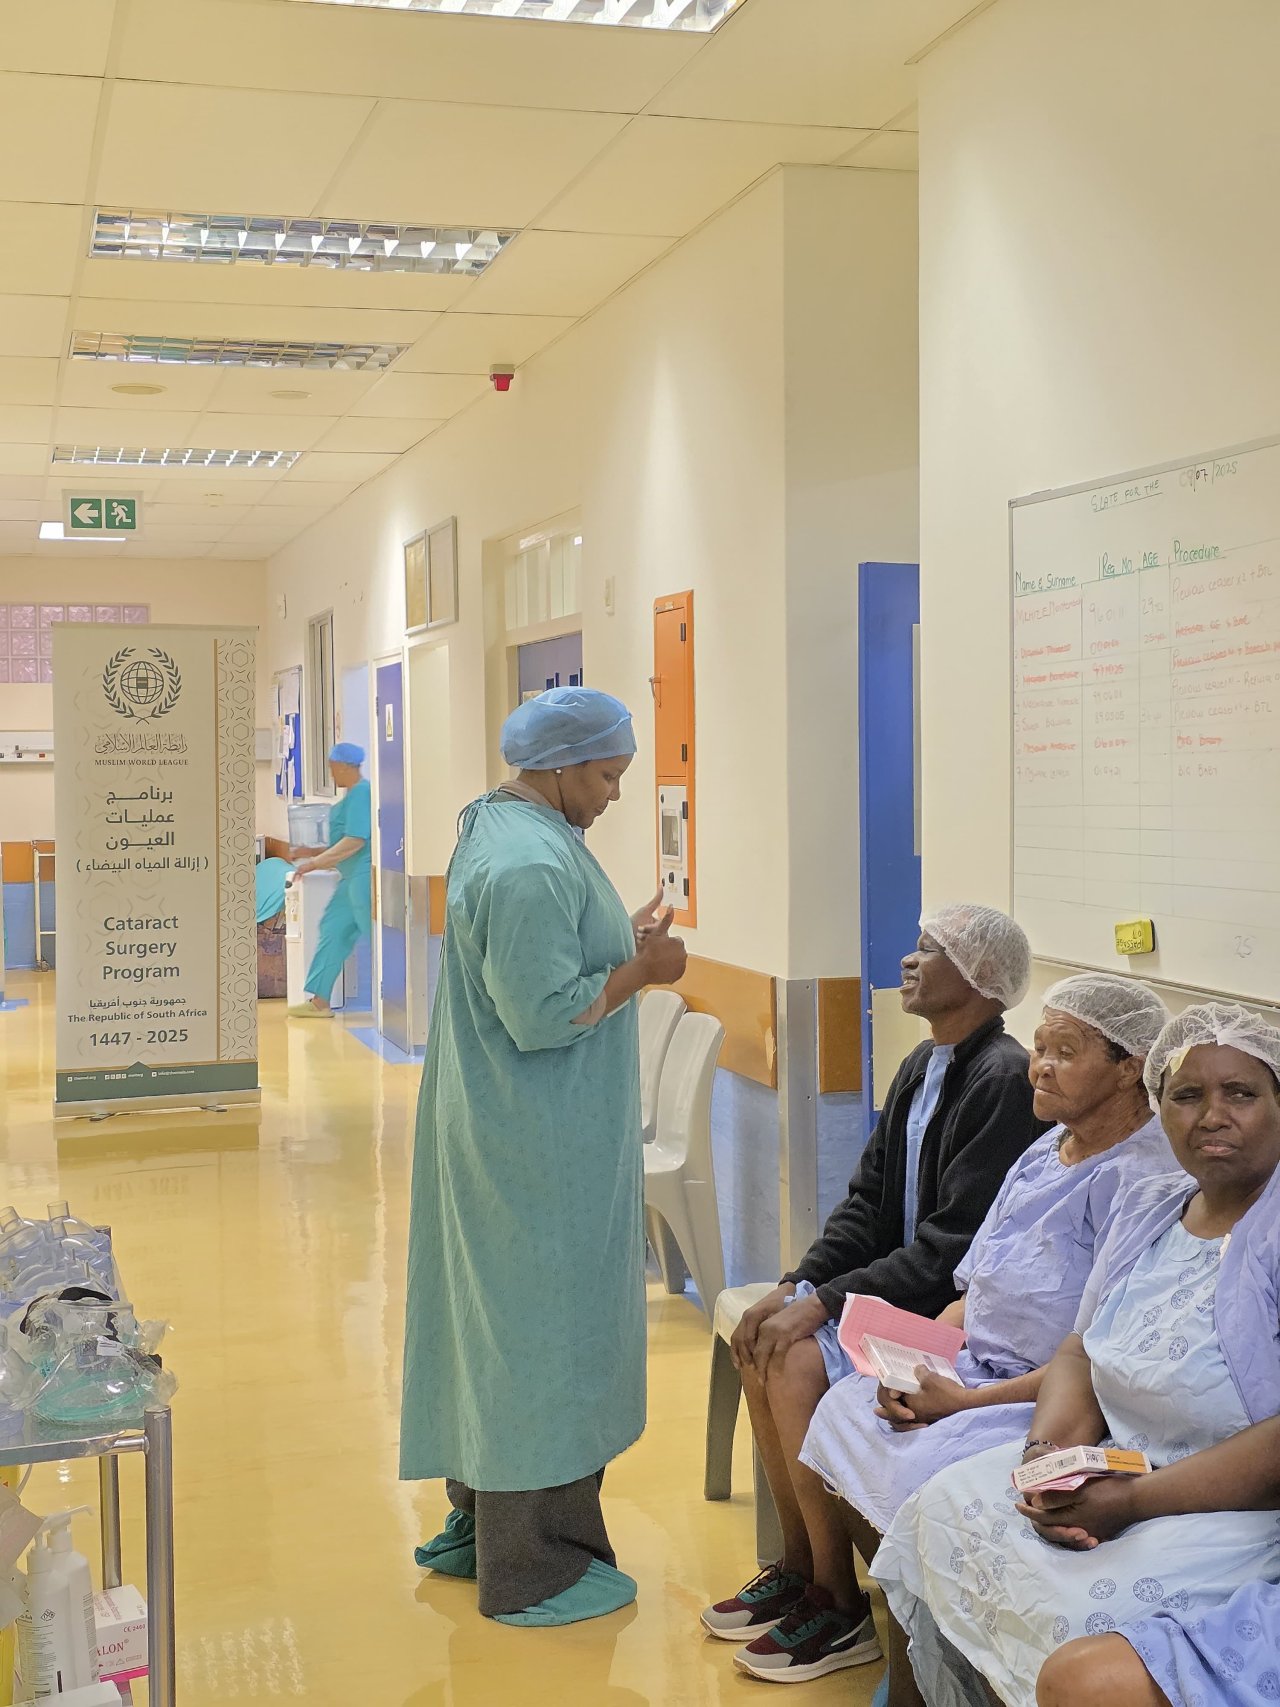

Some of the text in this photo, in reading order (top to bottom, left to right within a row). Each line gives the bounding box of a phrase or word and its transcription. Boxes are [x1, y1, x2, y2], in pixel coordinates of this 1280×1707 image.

[1124, 485, 1141, 501] FOR
[1144, 479, 1160, 492] THE
[1015, 570, 1036, 593] Name
[1046, 573, 1077, 589] Surname
[1142, 551, 1159, 567] AGE
[1173, 539, 1220, 562] Procedure
[103, 915, 179, 931] Cataract
[105, 940, 177, 959] Surgery
[102, 965, 180, 983] Program
[122, 998, 148, 1009] جنوب
[149, 996, 187, 1007] جمهورية
[68, 1008, 208, 1023] The Republic of South Africa
[89, 1031, 131, 1047] 1447
[147, 1028, 189, 1044] 2025
